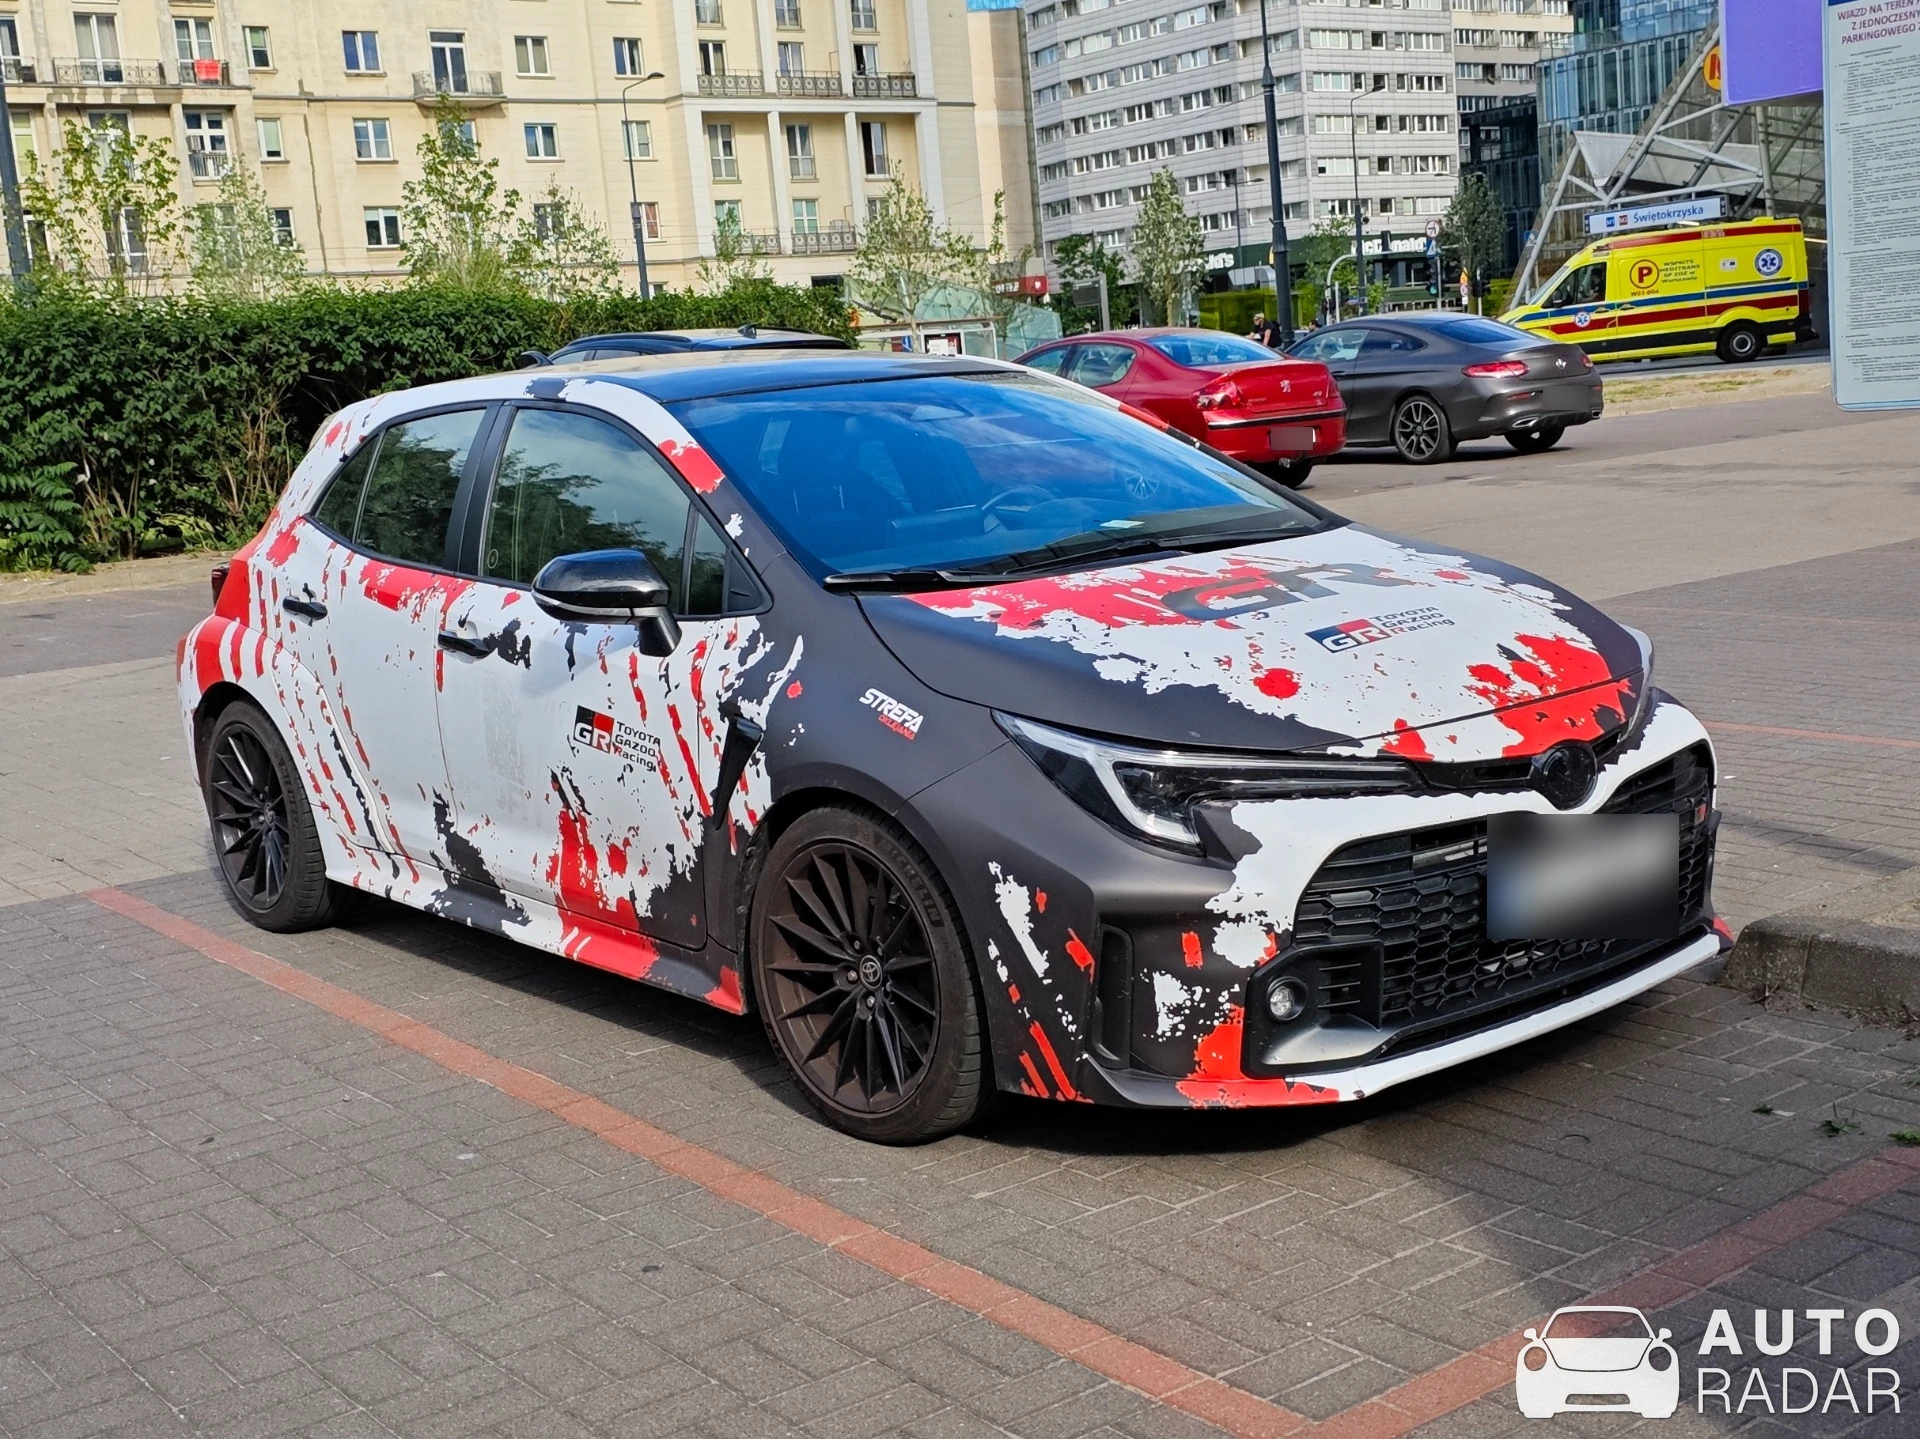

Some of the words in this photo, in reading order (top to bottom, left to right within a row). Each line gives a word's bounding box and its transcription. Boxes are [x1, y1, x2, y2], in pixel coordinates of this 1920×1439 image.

[1837, 8, 1867, 20] WJAZD
[1870, 4, 1883, 14] NA
[1885, 0, 1914, 11] TEREN
[1842, 23, 1916, 44] PARKINGOWEGO
[1852, 22, 1857, 30] Z
[1633, 205, 1704, 222] Świętokrzyska
[1638, 266, 1653, 283] P
[1369, 606, 1440, 623] TOYOTA
[1381, 612, 1444, 628] GAZOO
[1390, 617, 1456, 635] Racing
[1322, 626, 1391, 652] GR
[858, 688, 924, 733] STREFA
[574, 722, 611, 754] GR
[617, 721, 661, 746] TOYOTA
[615, 734, 656, 757] GAZOO
[614, 745, 655, 772] Racing
[878, 838, 942, 924] MICHELIN
